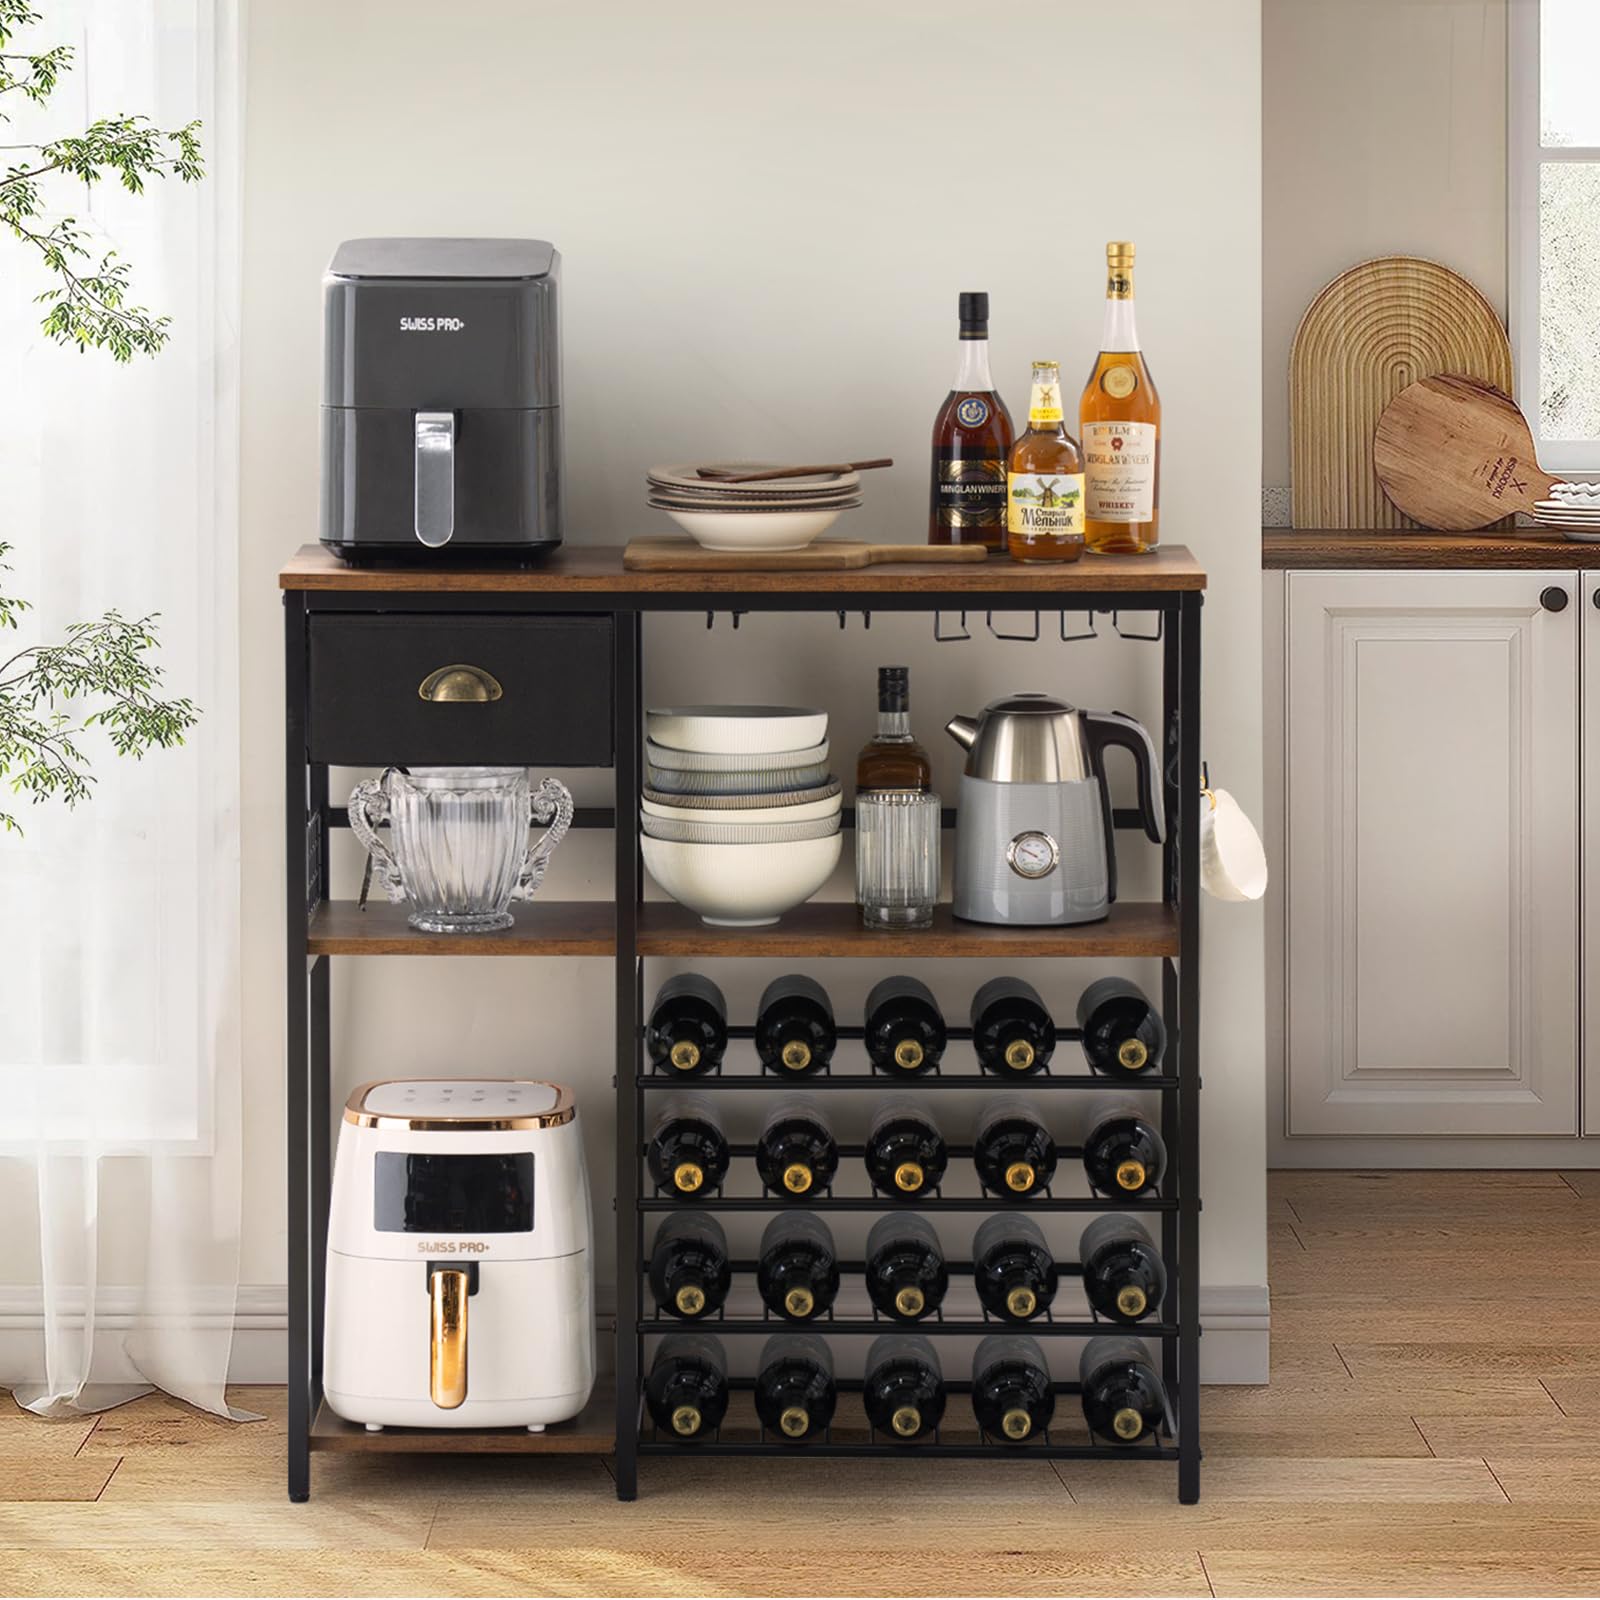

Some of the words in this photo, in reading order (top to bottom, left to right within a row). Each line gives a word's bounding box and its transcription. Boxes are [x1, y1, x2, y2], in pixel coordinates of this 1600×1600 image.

[400, 317, 435, 331] SWISS
[1098, 501, 1136, 509] WHISKEY
[417, 1242, 456, 1253] SWISS
